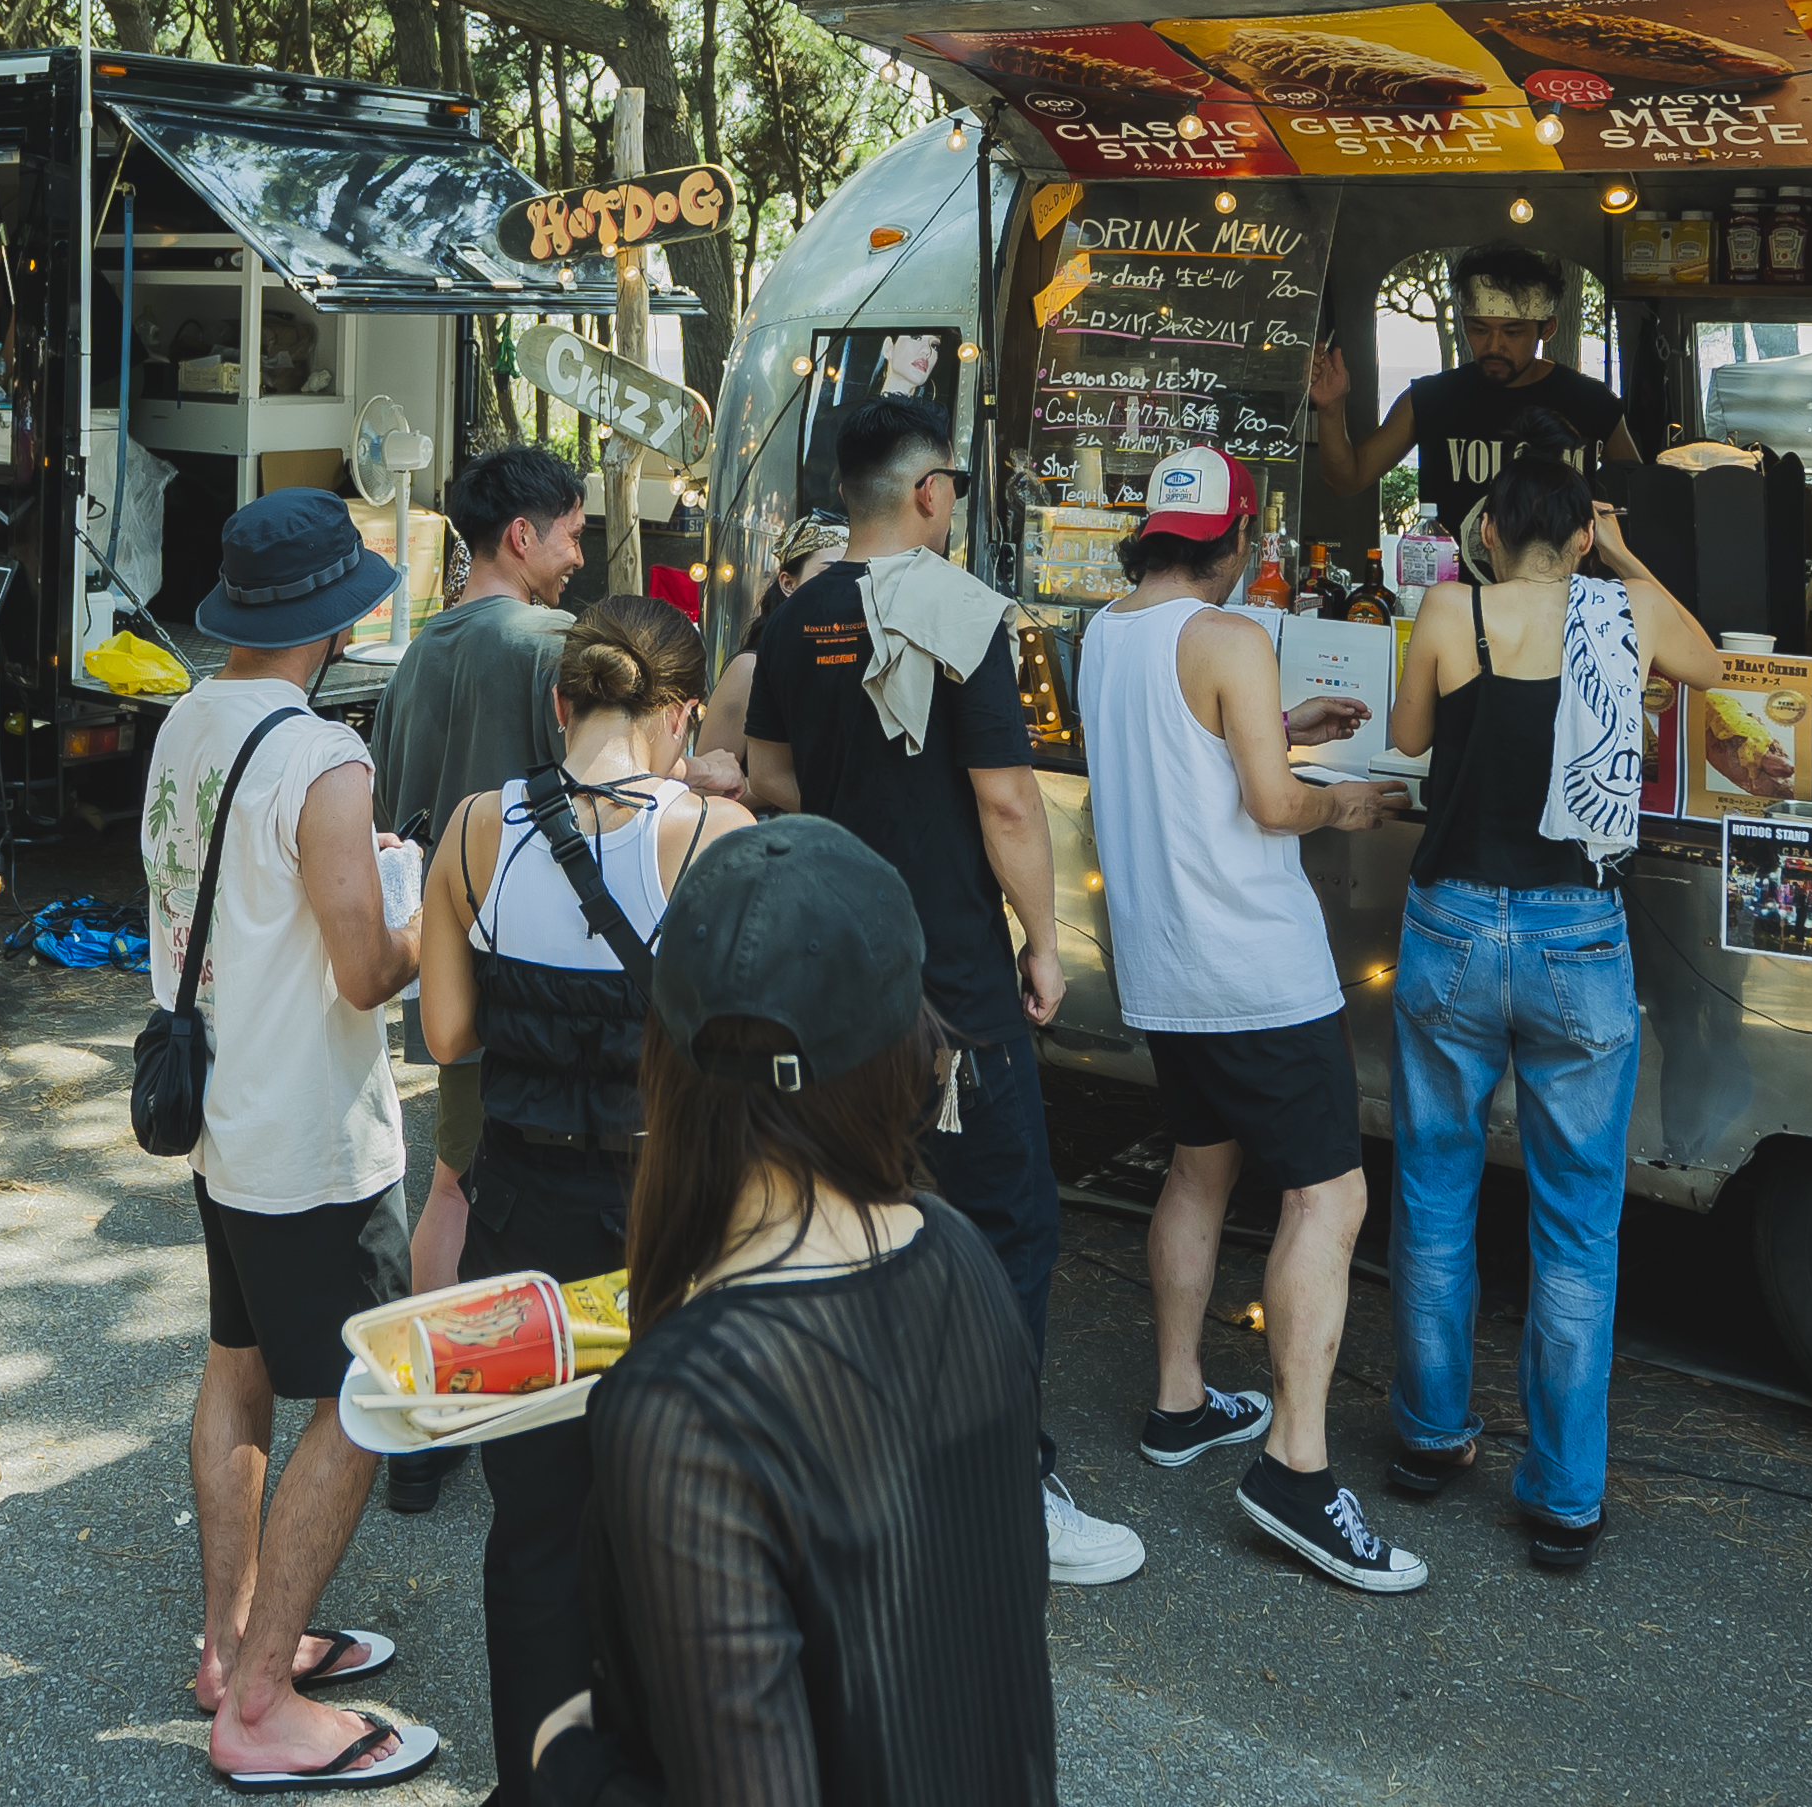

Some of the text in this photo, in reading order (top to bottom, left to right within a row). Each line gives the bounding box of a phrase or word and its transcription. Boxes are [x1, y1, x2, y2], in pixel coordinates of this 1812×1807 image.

[1534, 80, 1603, 93] 1000
[1035, 100, 1074, 108] 900
[1549, 92, 1606, 103] YEN
[1629, 94, 1741, 106] WAGYU
[1290, 111, 1523, 135] GERMAN
[1609, 105, 1776, 127] MEAT
[1334, 133, 1503, 155] STYLE
[1599, 123, 1809, 148] SAUCE
[1097, 140, 1246, 160] STYLE
[1653, 149, 1764, 162] 和牛ミートソース
[1133, 161, 1227, 171] クラシックスタイル
[1372, 156, 1479, 166] ジャーマンスタイル
[1076, 217, 1303, 255] DRINK MENU
[1112, 263, 1166, 290] draft
[1049, 358, 1106, 387] Lemon
[1110, 371, 1150, 387] sour
[1045, 394, 1115, 429] Cocktail
[1041, 454, 1081, 480] Shot
[1057, 482, 1109, 507] Tequila
[1165, 493, 1193, 501] SUPPORT
[1735, 659, 1765, 674] MEAT
[1767, 662, 1808, 678] CHEESE
[1732, 823, 1810, 843] HOTDOG STAND
